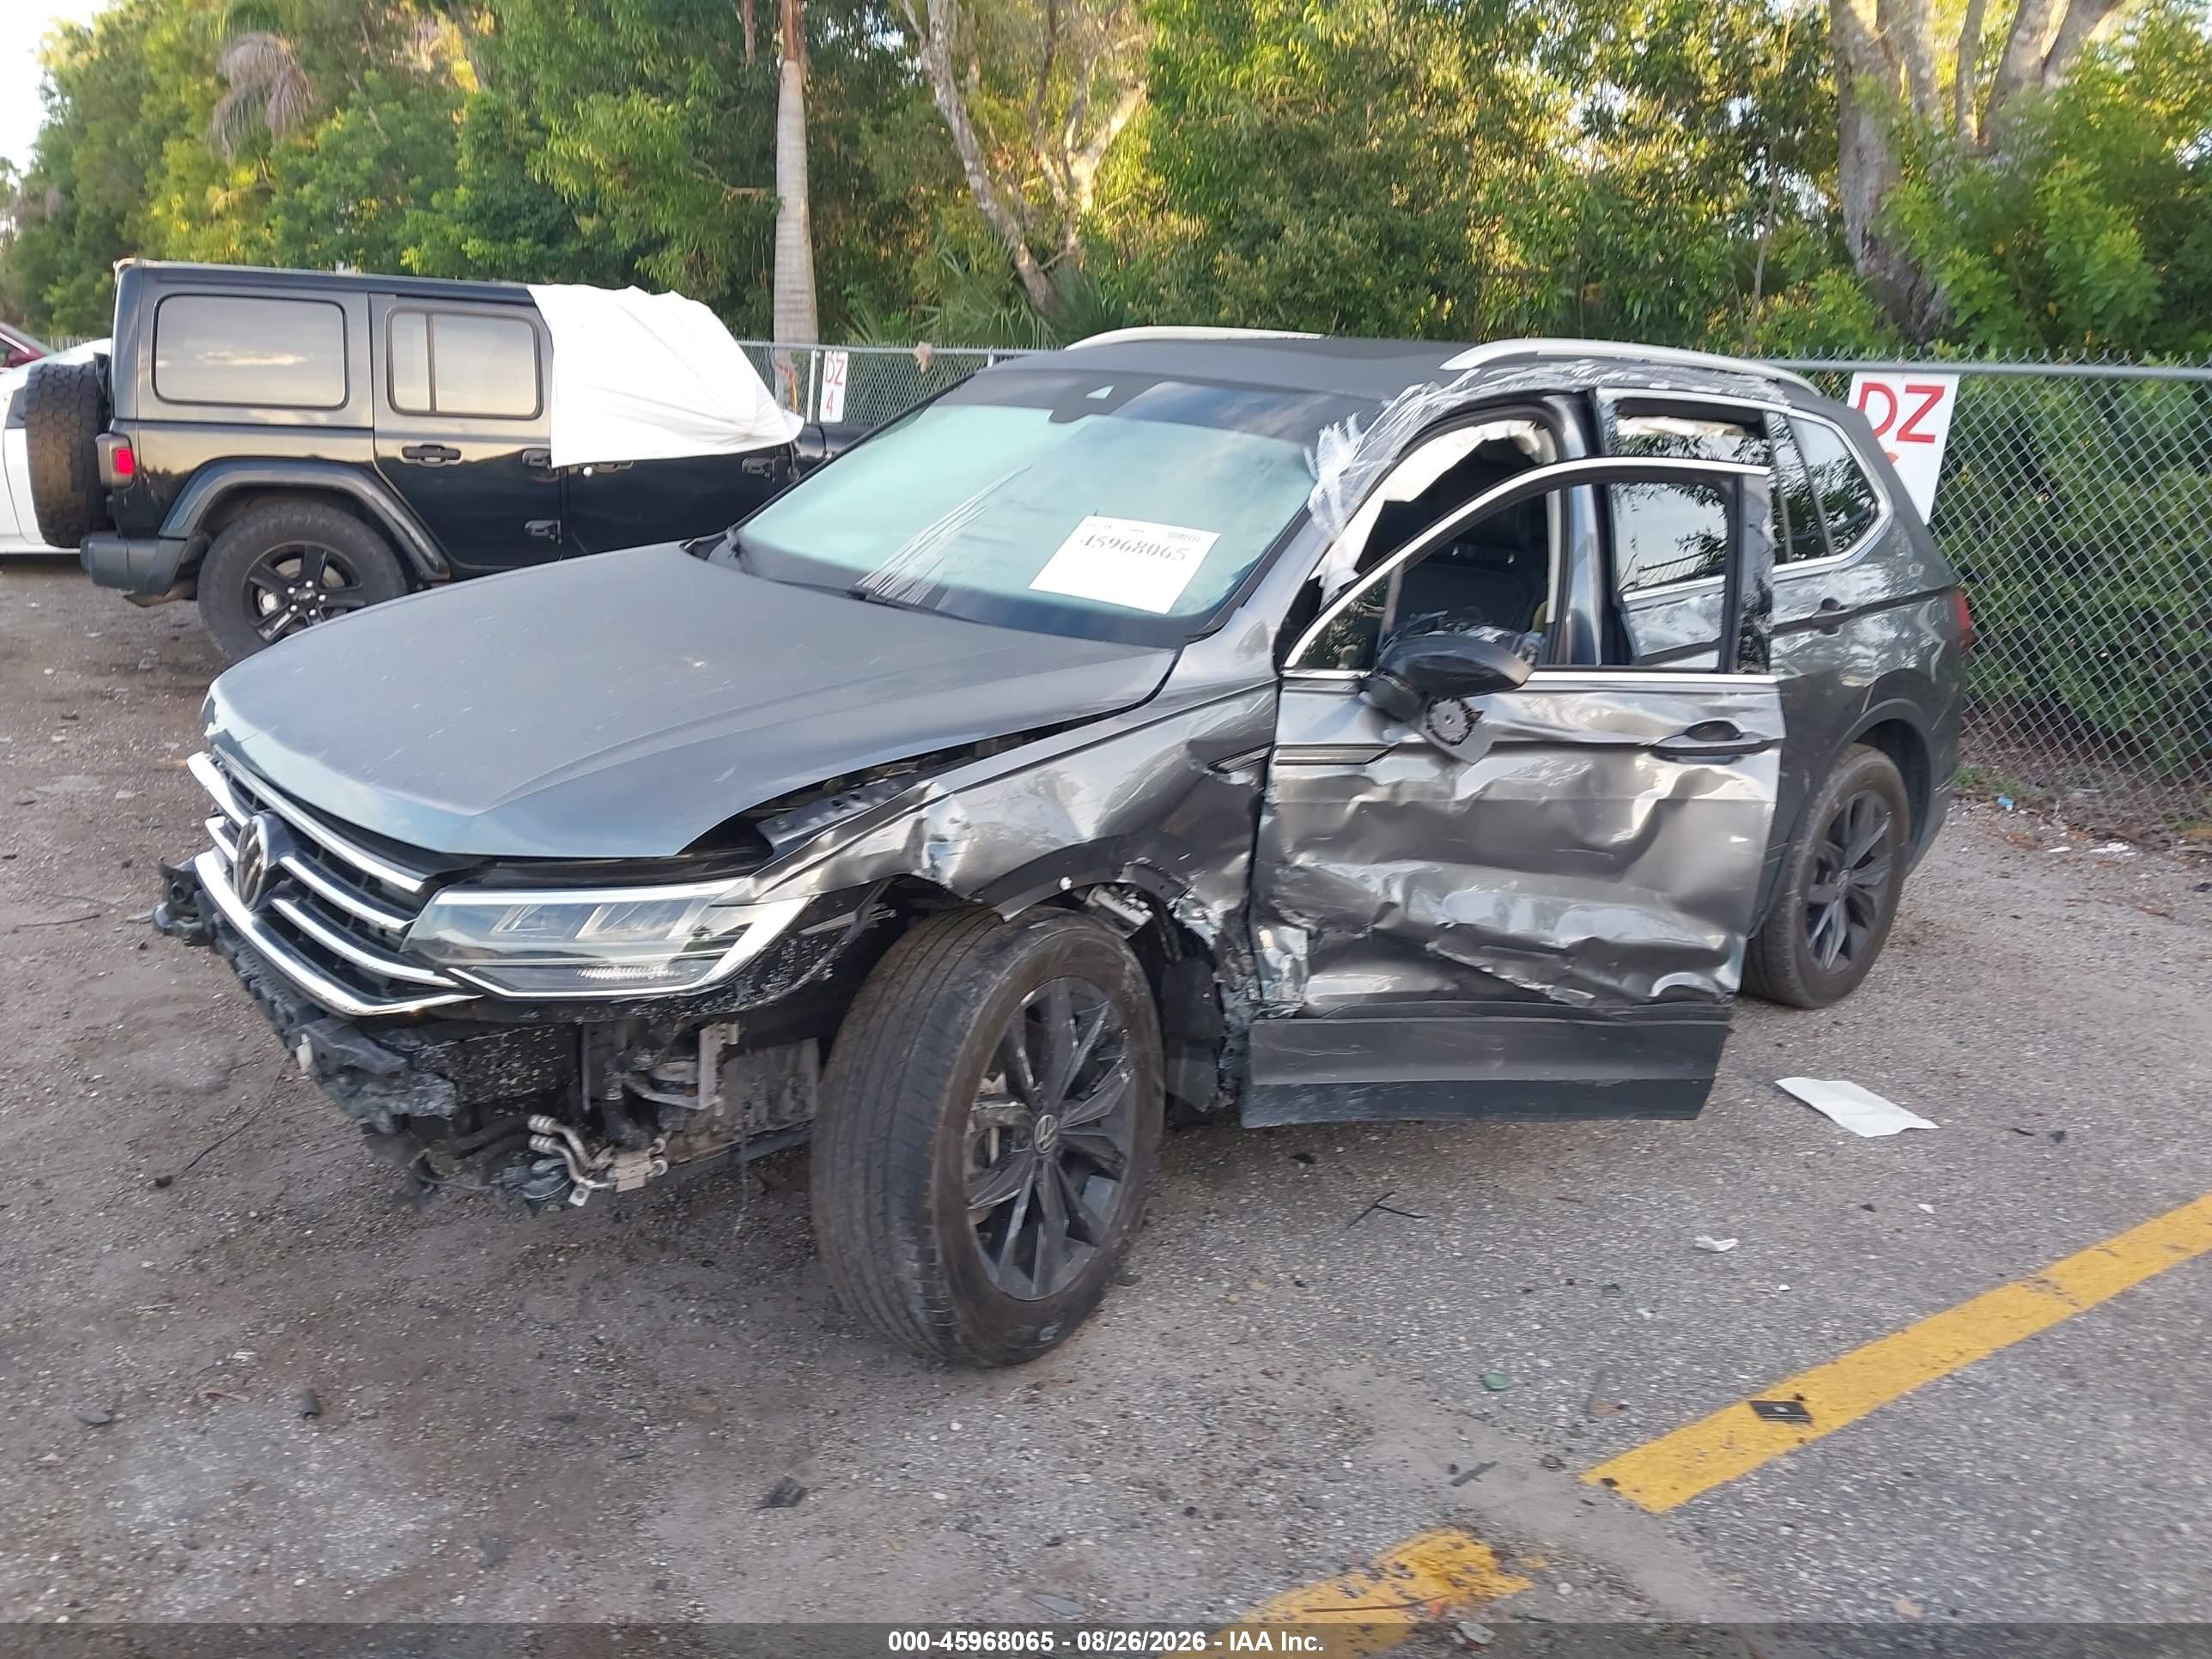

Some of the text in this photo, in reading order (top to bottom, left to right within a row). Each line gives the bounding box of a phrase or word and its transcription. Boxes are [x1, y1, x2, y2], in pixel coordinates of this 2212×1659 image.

[825, 356, 845, 385] DZ
[826, 390, 834, 417] 4
[1857, 382, 1945, 443] DZ
[1079, 534, 1190, 561] 45968065
